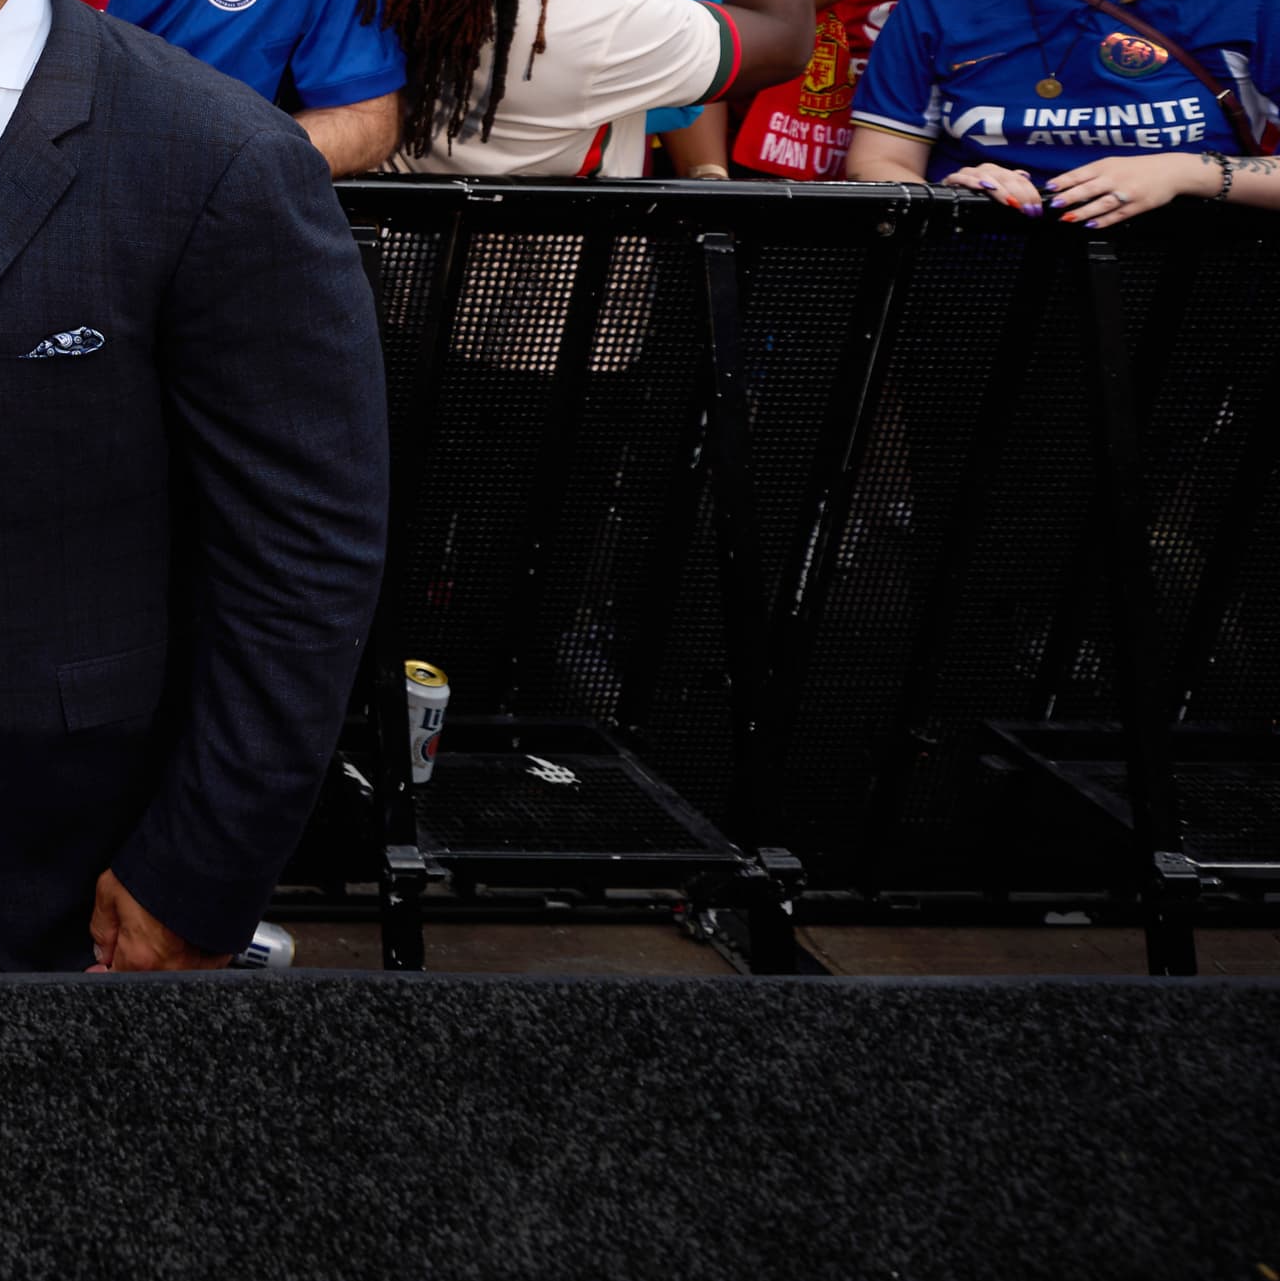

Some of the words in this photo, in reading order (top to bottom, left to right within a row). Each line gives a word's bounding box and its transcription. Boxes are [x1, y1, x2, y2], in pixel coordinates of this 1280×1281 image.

[1023, 97, 1206, 128] INFINITE
[812, 124, 852, 147] GLO
[1026, 121, 1207, 148] ATHLETE
[760, 132, 809, 171] MAN
[813, 145, 848, 176] UT
